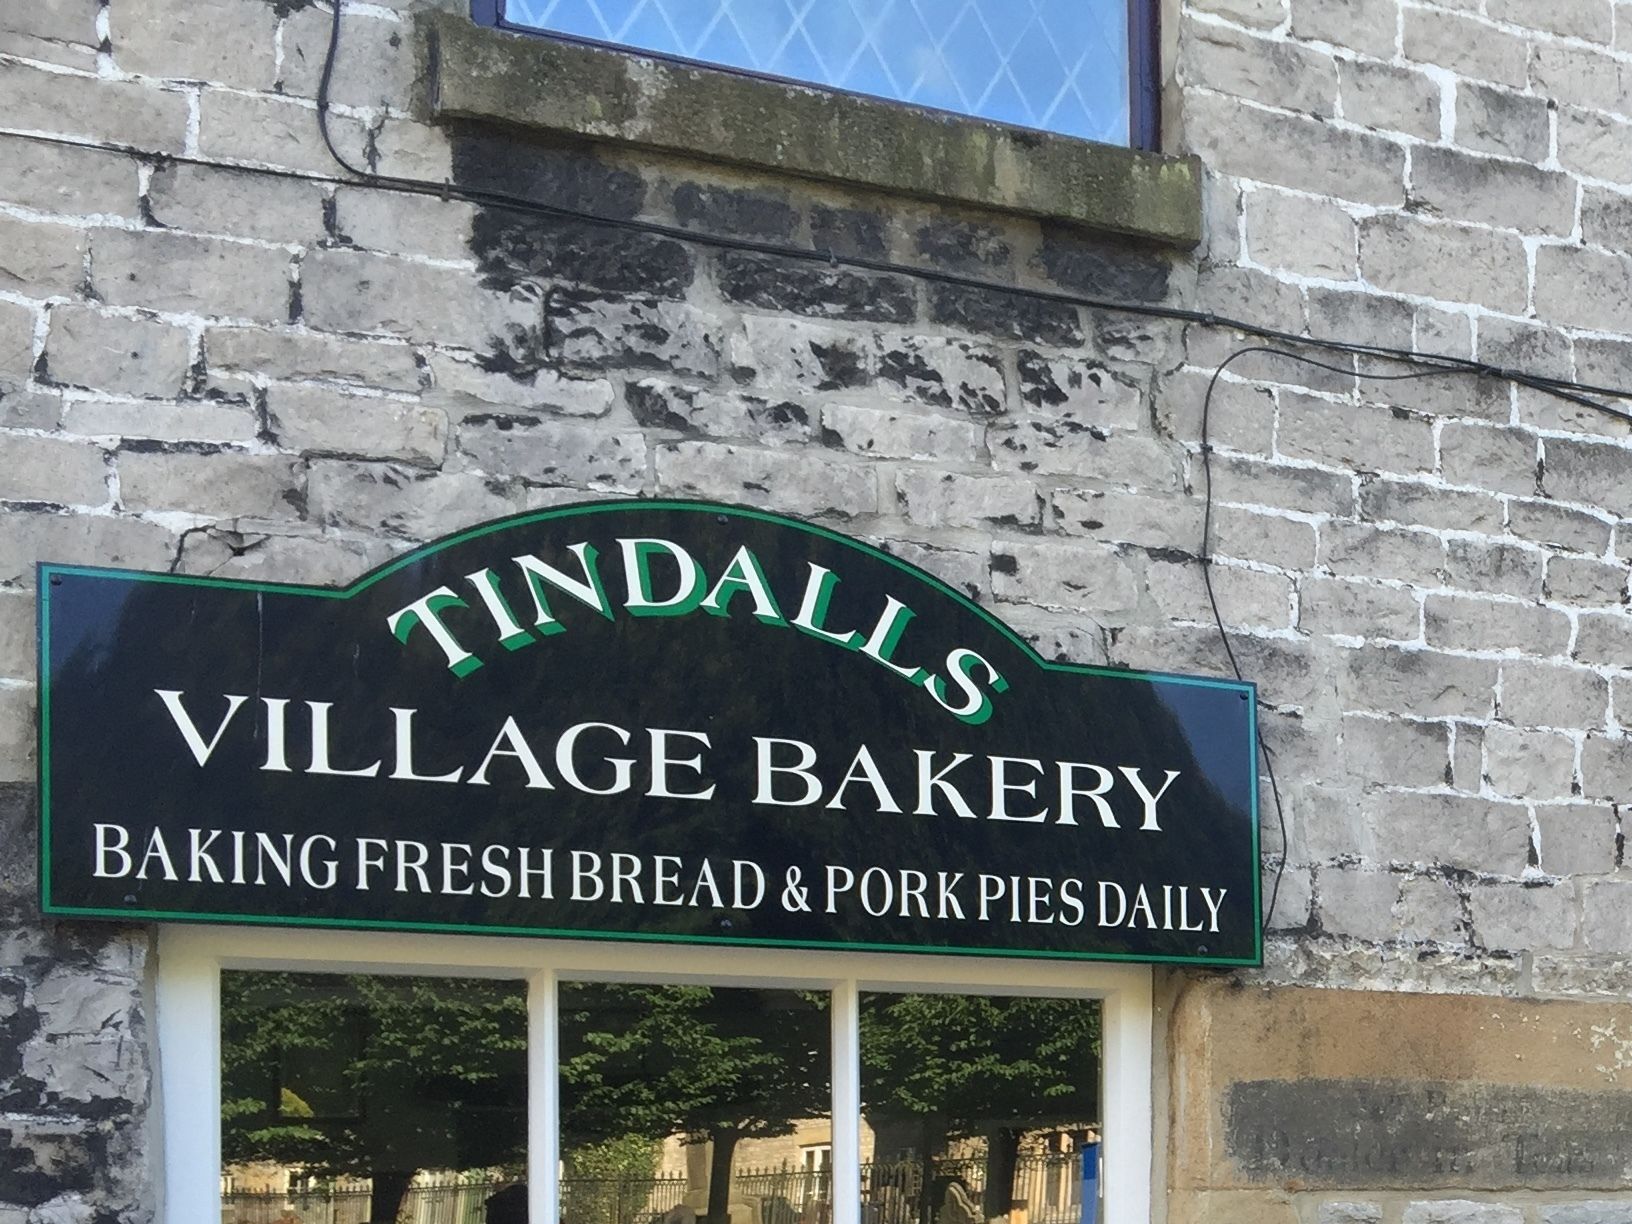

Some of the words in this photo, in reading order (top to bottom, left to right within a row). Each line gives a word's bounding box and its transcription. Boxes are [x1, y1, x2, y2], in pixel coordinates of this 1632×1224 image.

[387, 537, 1008, 724] TINDALLS
[154, 688, 716, 799] VILLAGE
[752, 736, 1181, 831] BAKERY
[93, 822, 338, 889] BAKING
[355, 837, 554, 900] FRESH
[570, 849, 766, 910] BREAD
[781, 864, 811, 913] &
[826, 864, 967, 921] PORK
[979, 874, 1086, 927] PIES
[1098, 881, 1229, 933] DAILY
